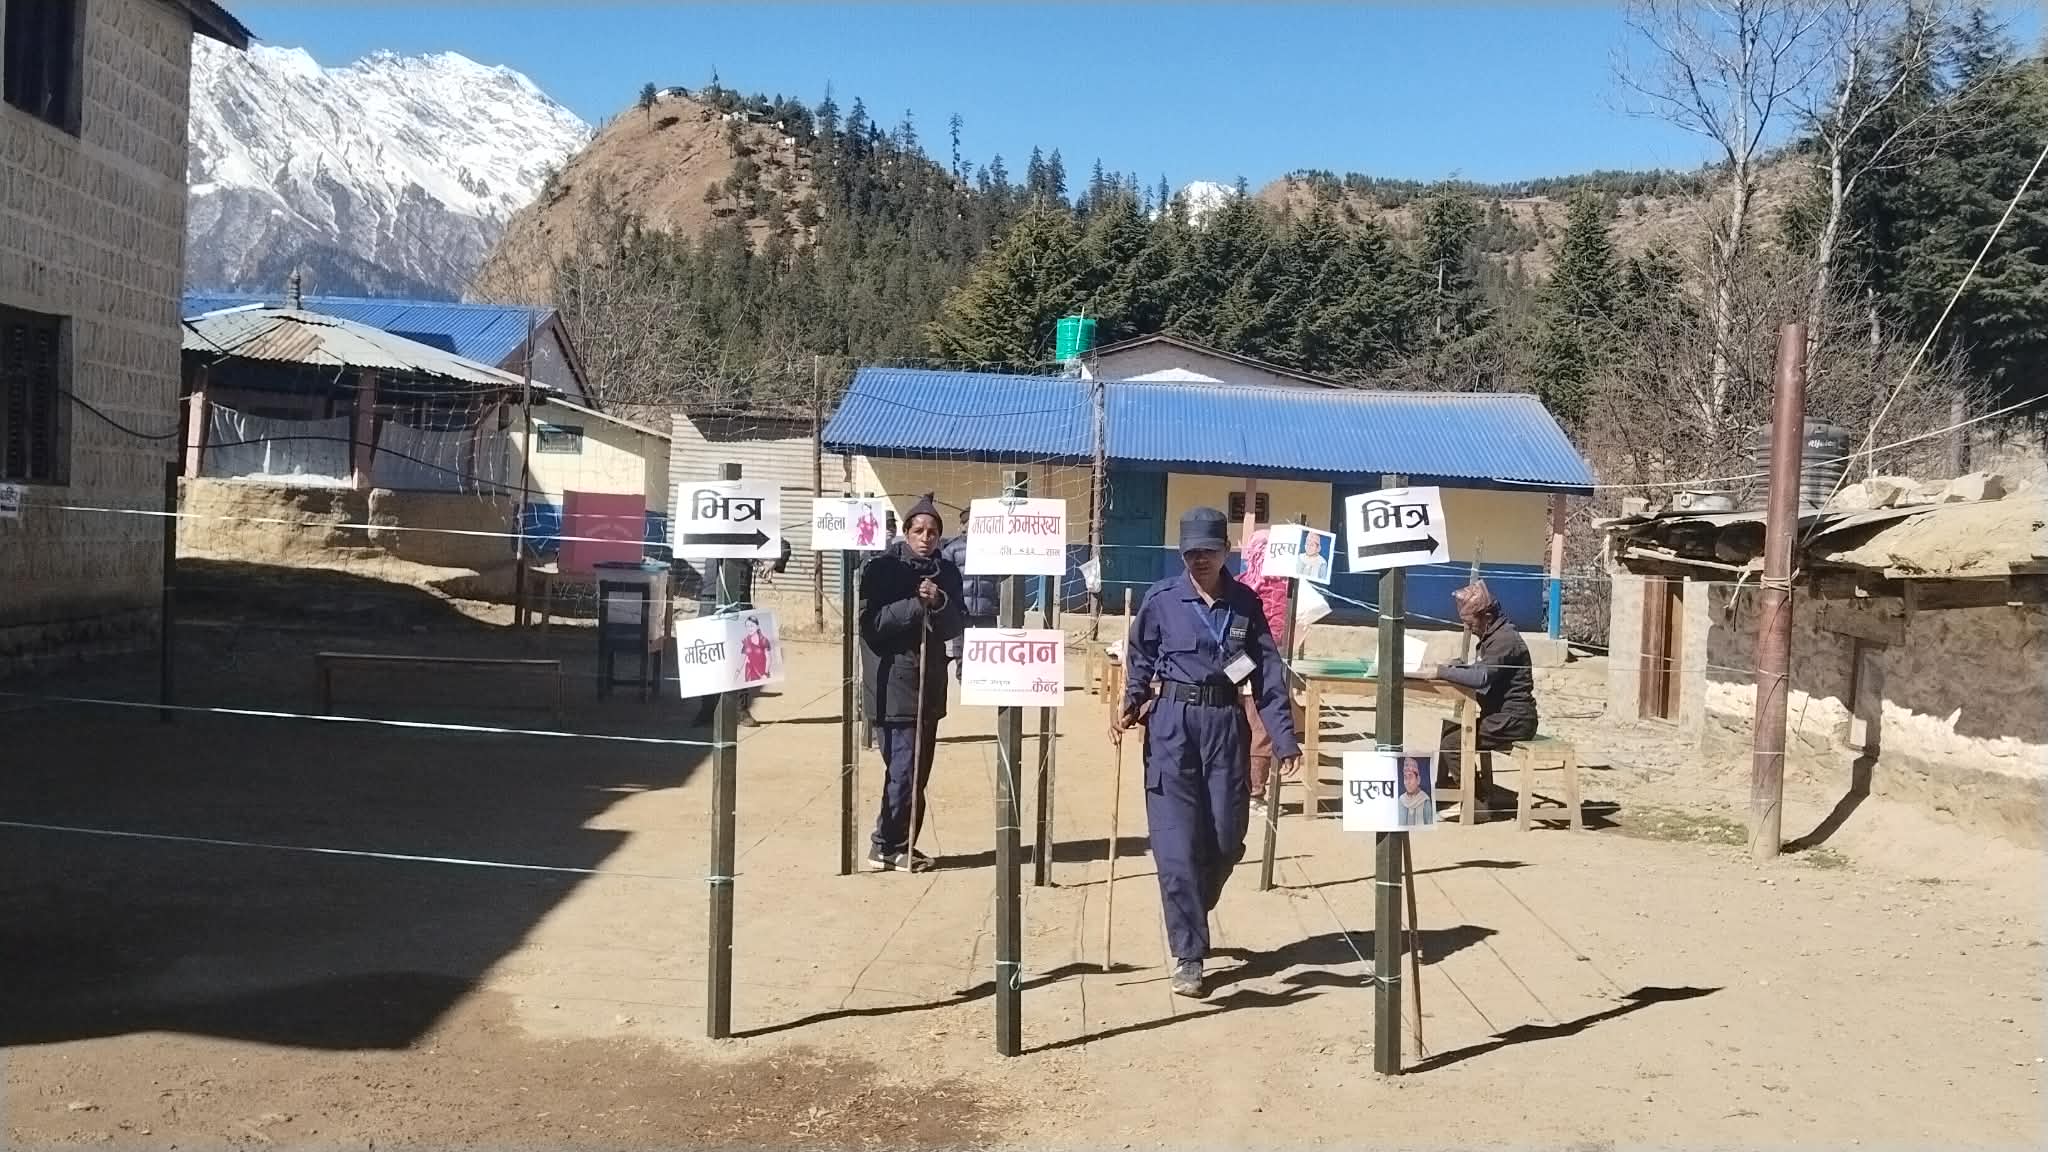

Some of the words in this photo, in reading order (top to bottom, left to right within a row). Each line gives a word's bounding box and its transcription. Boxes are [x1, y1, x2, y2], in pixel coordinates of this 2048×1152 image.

[691, 488, 765, 522] भित्र
[1361, 499, 1430, 532] भित्र
[817, 512, 846, 531] महिला
[1008, 511, 1061, 536] क्रमसंख्या
[684, 638, 726, 665] महिला
[968, 639, 1059, 666] मतदान
[1032, 677, 1059, 695] केन्द्र
